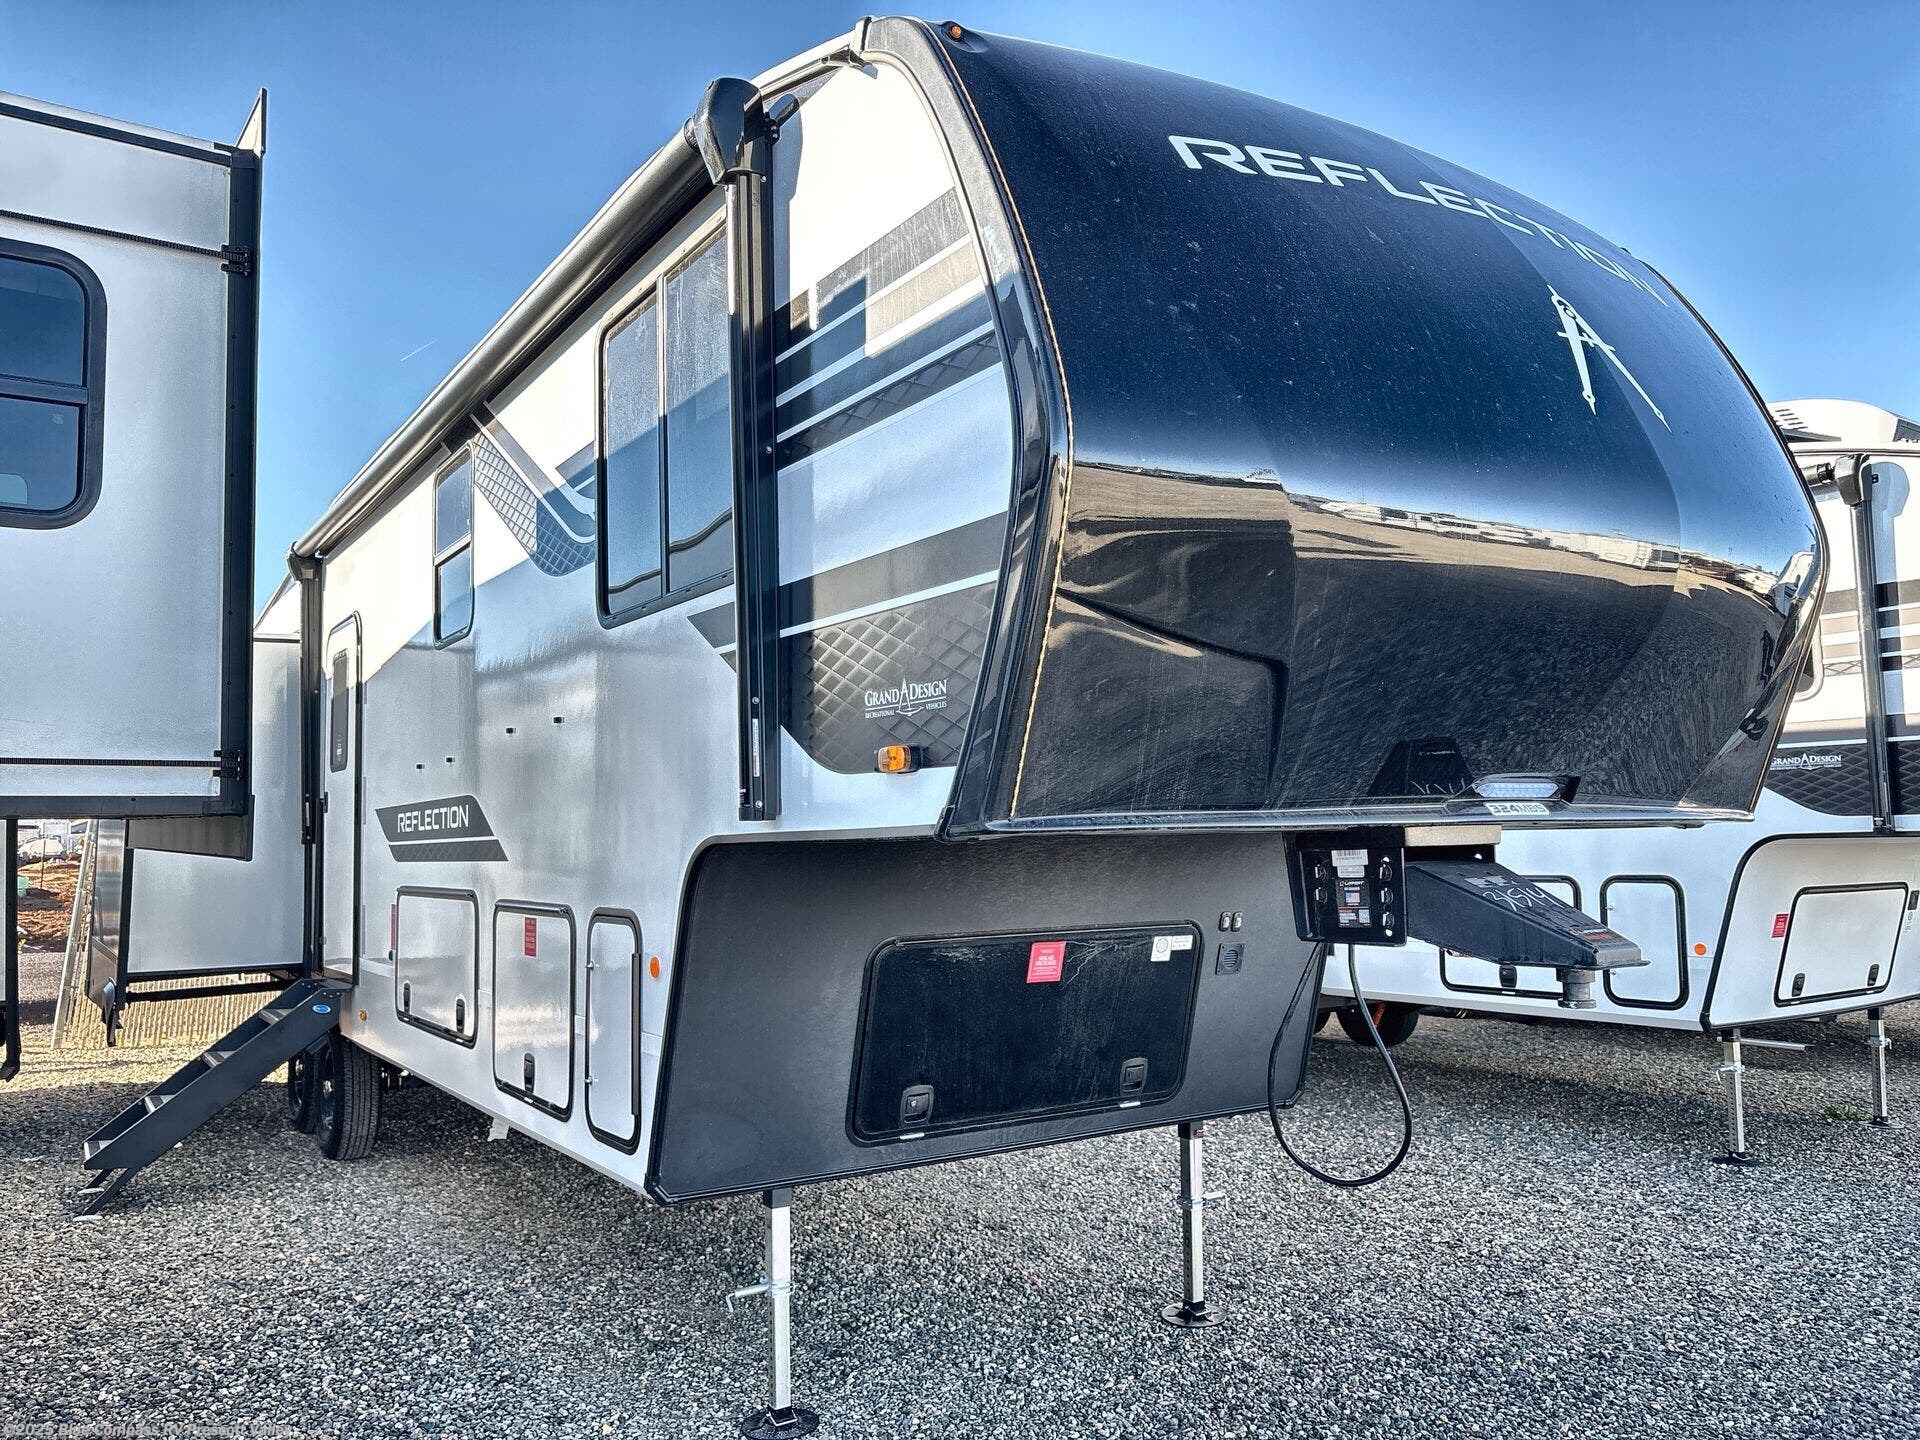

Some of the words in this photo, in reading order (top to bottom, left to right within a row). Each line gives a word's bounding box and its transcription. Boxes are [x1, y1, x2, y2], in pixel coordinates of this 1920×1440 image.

[1168, 135, 1669, 307] REFLECTION
[864, 688, 900, 707] GRAND
[909, 678, 948, 700] DESIGN
[1809, 754, 1842, 763] DESIGN
[397, 804, 469, 833] REFLECTION
